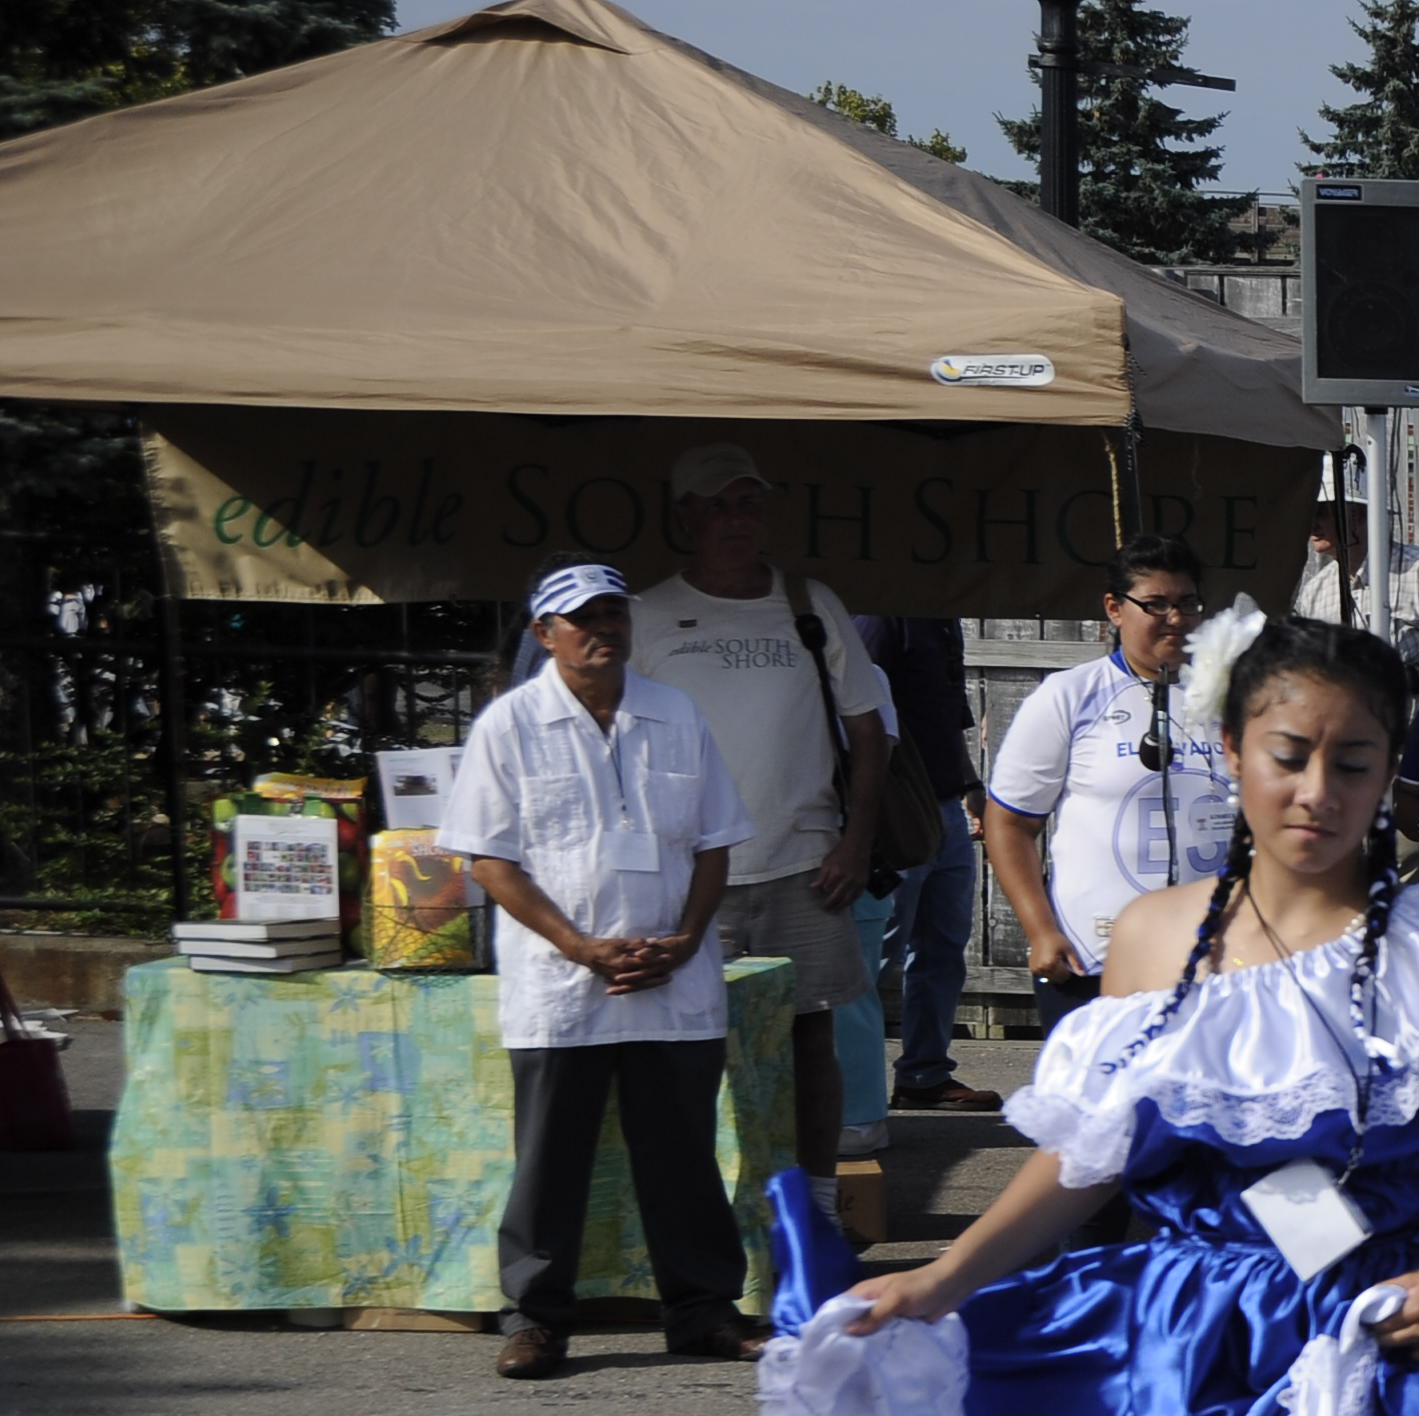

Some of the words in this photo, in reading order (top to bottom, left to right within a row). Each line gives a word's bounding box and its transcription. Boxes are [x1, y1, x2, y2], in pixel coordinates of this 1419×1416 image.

[213, 457, 463, 548] edible
[715, 638, 792, 655] SOUTH
[721, 652, 798, 670] SHORE
[1117, 741, 1141, 758] EL
